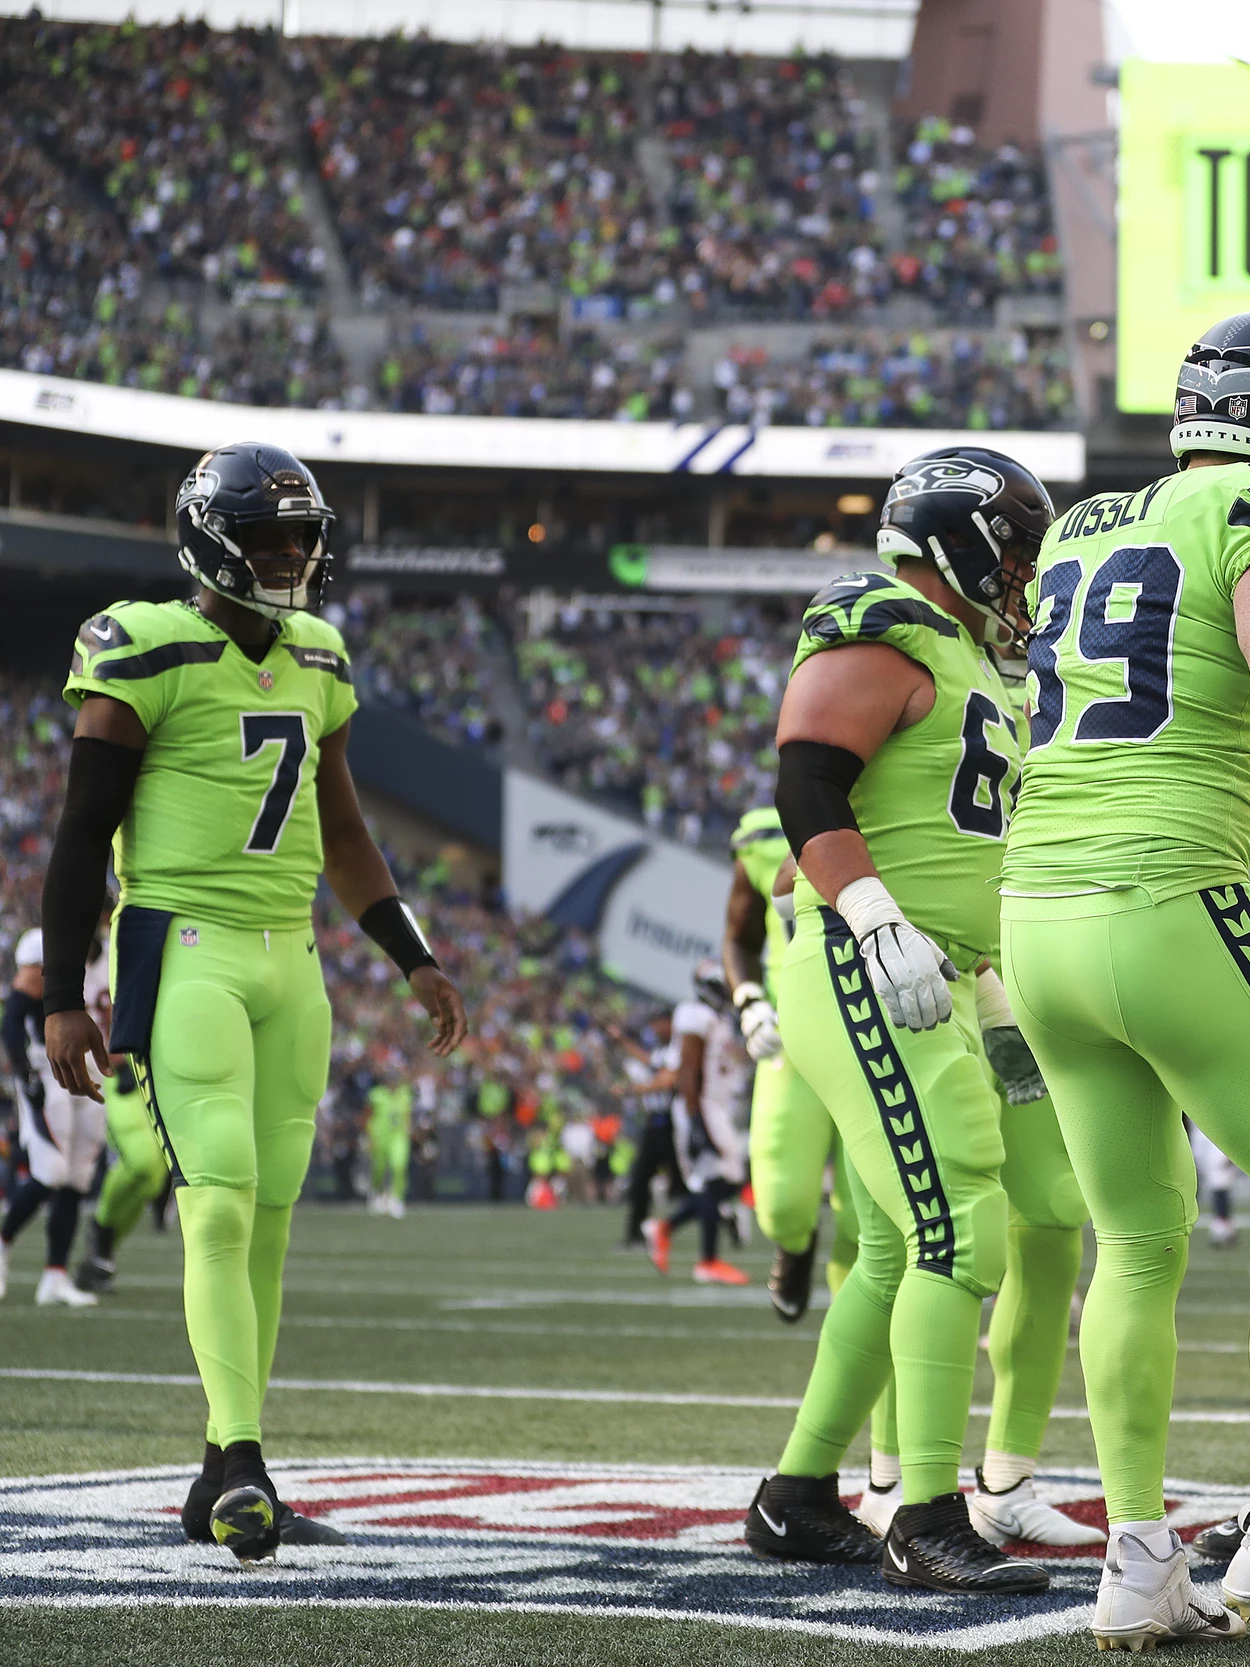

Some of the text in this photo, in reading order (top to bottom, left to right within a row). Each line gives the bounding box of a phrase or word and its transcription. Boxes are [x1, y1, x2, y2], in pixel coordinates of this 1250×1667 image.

[1058, 478, 1172, 542] DISSLY
[1026, 542, 1186, 752] 89
[239, 711, 309, 855] 7
